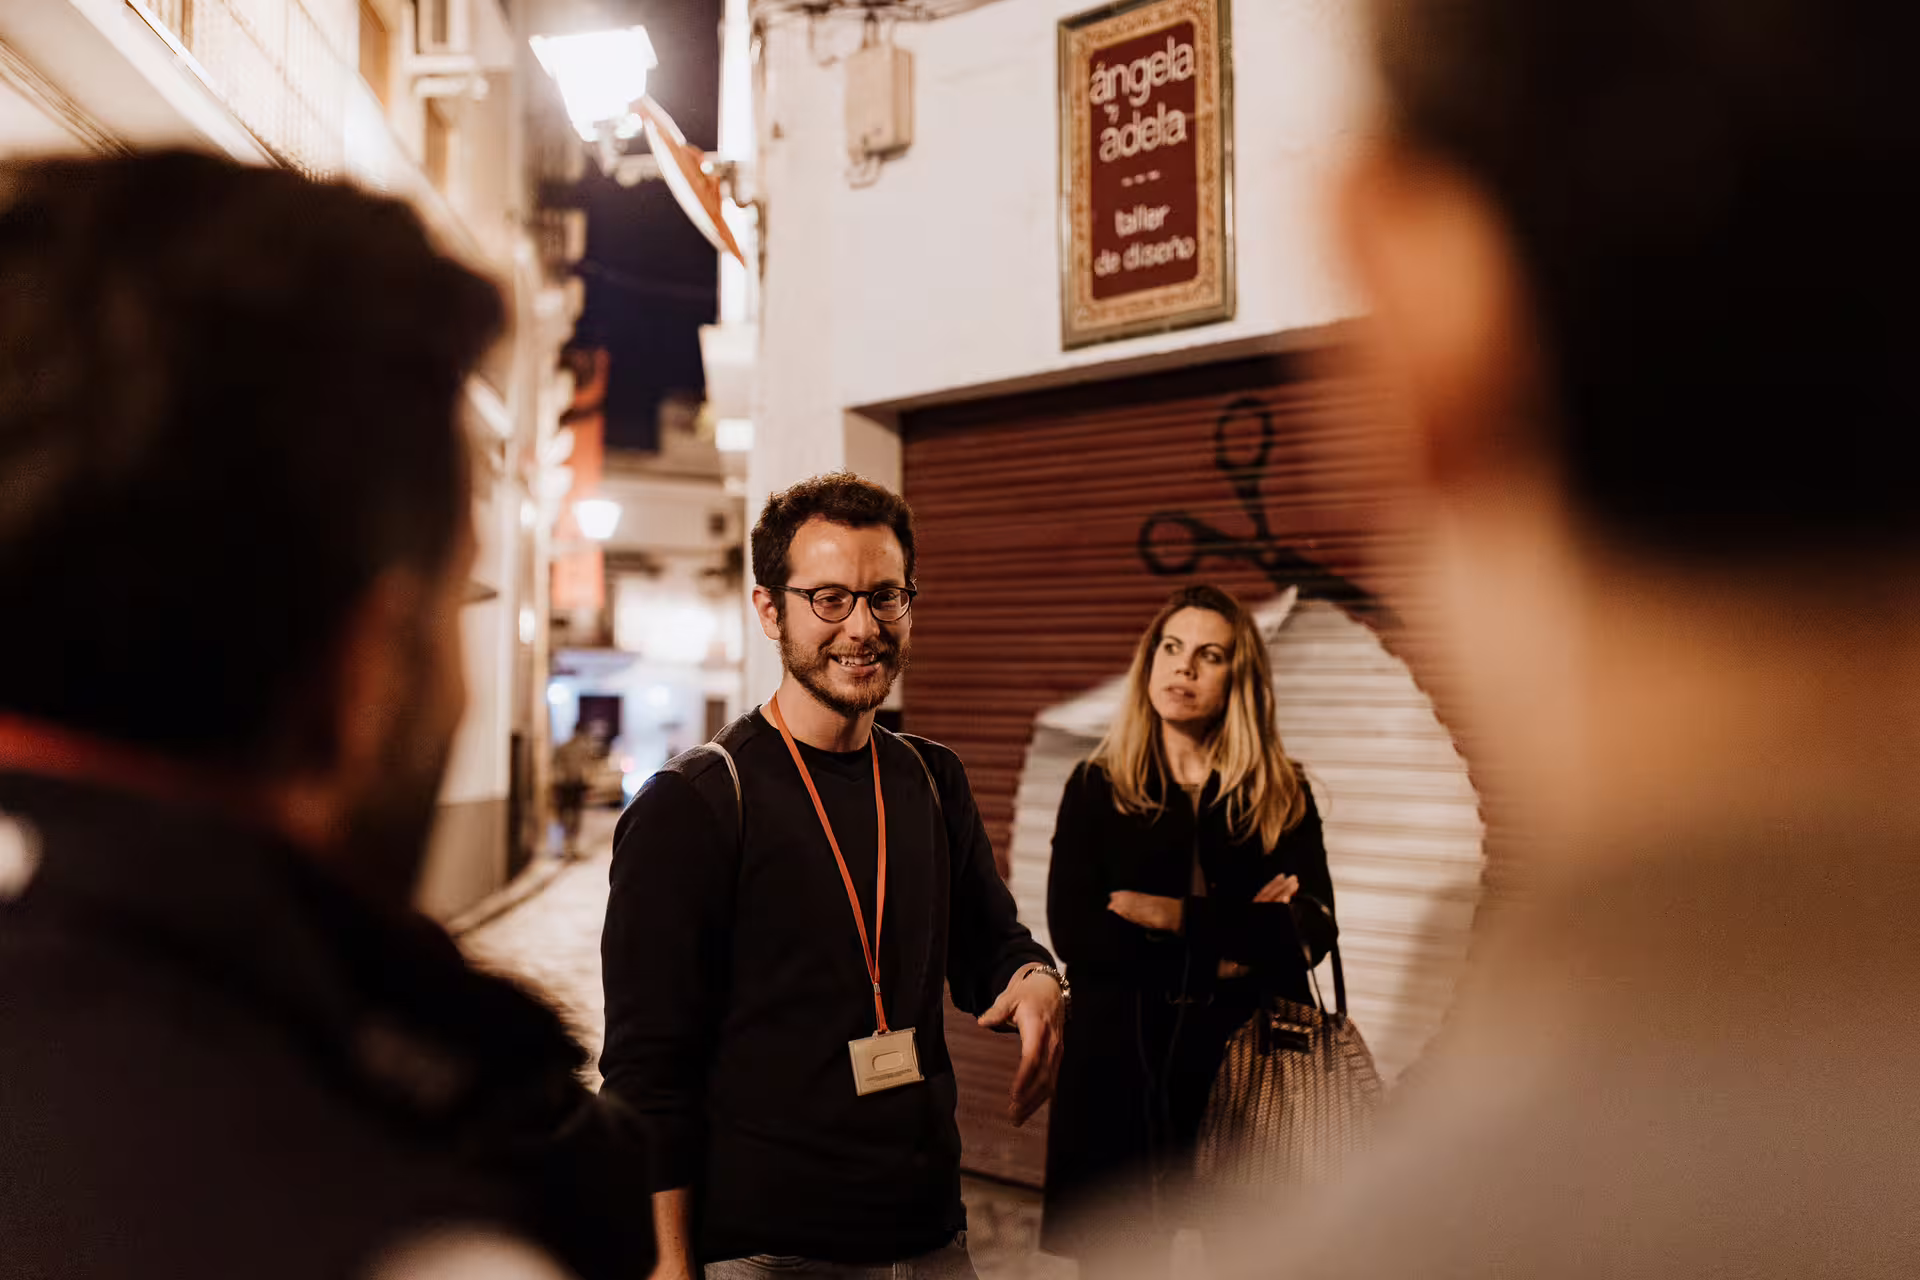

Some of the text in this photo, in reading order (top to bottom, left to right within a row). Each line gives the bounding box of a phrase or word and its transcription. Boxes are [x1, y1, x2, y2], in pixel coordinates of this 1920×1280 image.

[1090, 36, 1195, 106] ángela
[1100, 103, 1187, 162] adela
[1115, 204, 1170, 237] taller
[1094, 235, 1195, 277] de diseño
